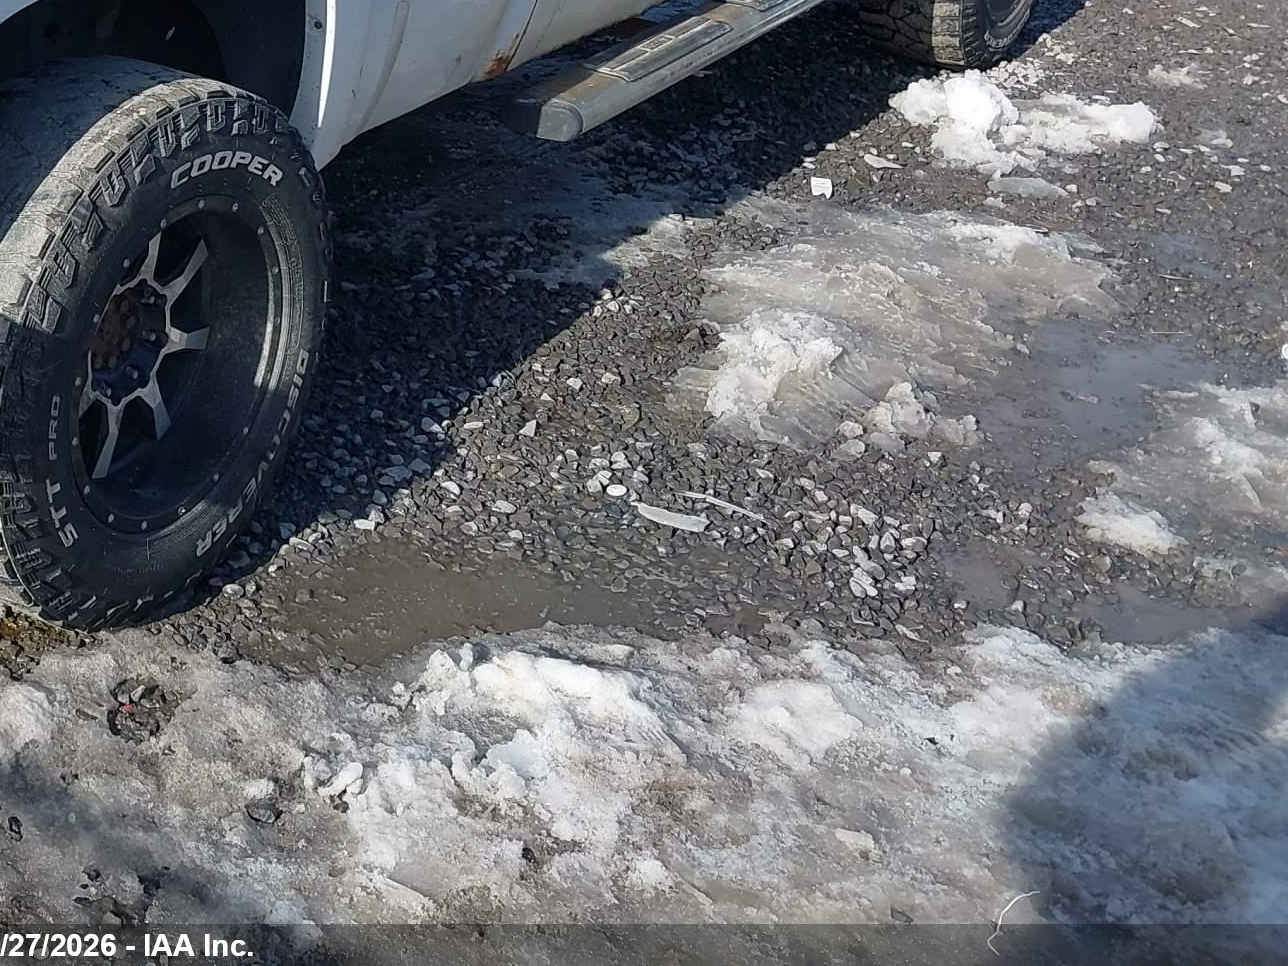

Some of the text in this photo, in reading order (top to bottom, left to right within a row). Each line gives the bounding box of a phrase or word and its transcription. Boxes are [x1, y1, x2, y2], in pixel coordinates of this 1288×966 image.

[170, 150, 283, 189] COOPER
[45, 395, 79, 549] STT PRO
[196, 347, 310, 557] DISCOVERER
